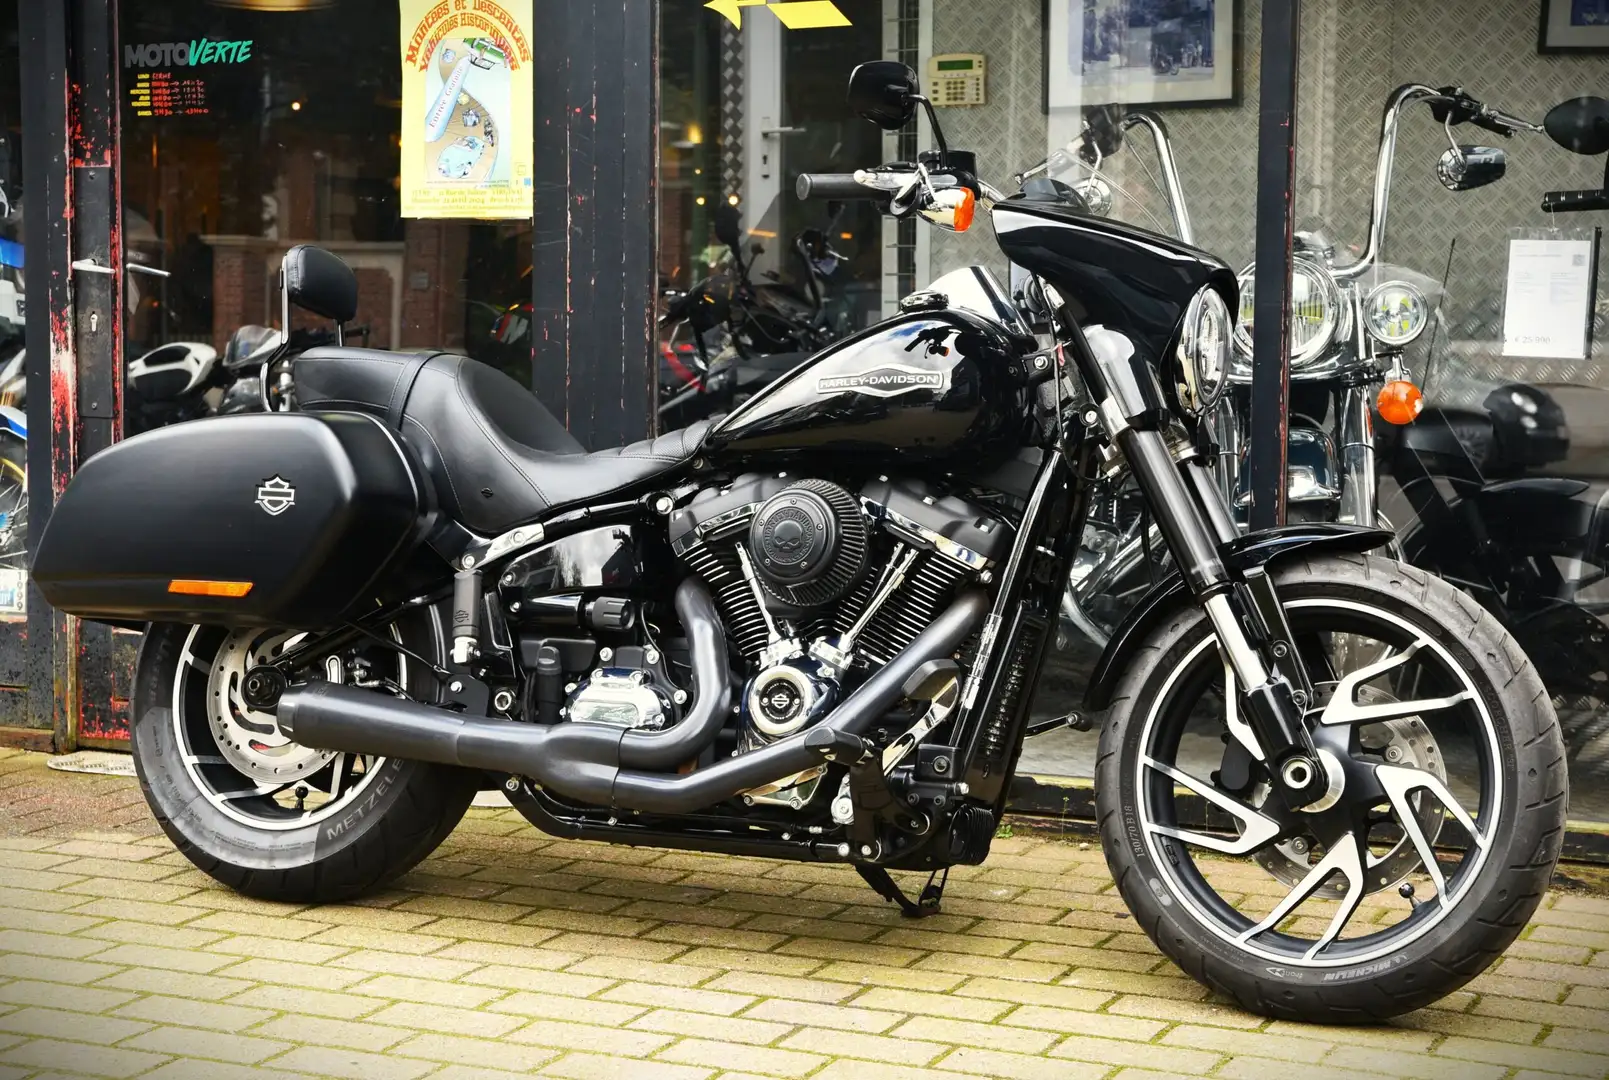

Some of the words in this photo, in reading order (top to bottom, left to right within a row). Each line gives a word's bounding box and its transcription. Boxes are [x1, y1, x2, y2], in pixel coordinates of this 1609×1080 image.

[820, 375, 937, 389] HARLEY-DAVIDSON
[326, 758, 405, 841] METZELE
[1323, 962, 1391, 981] MICHELIN
